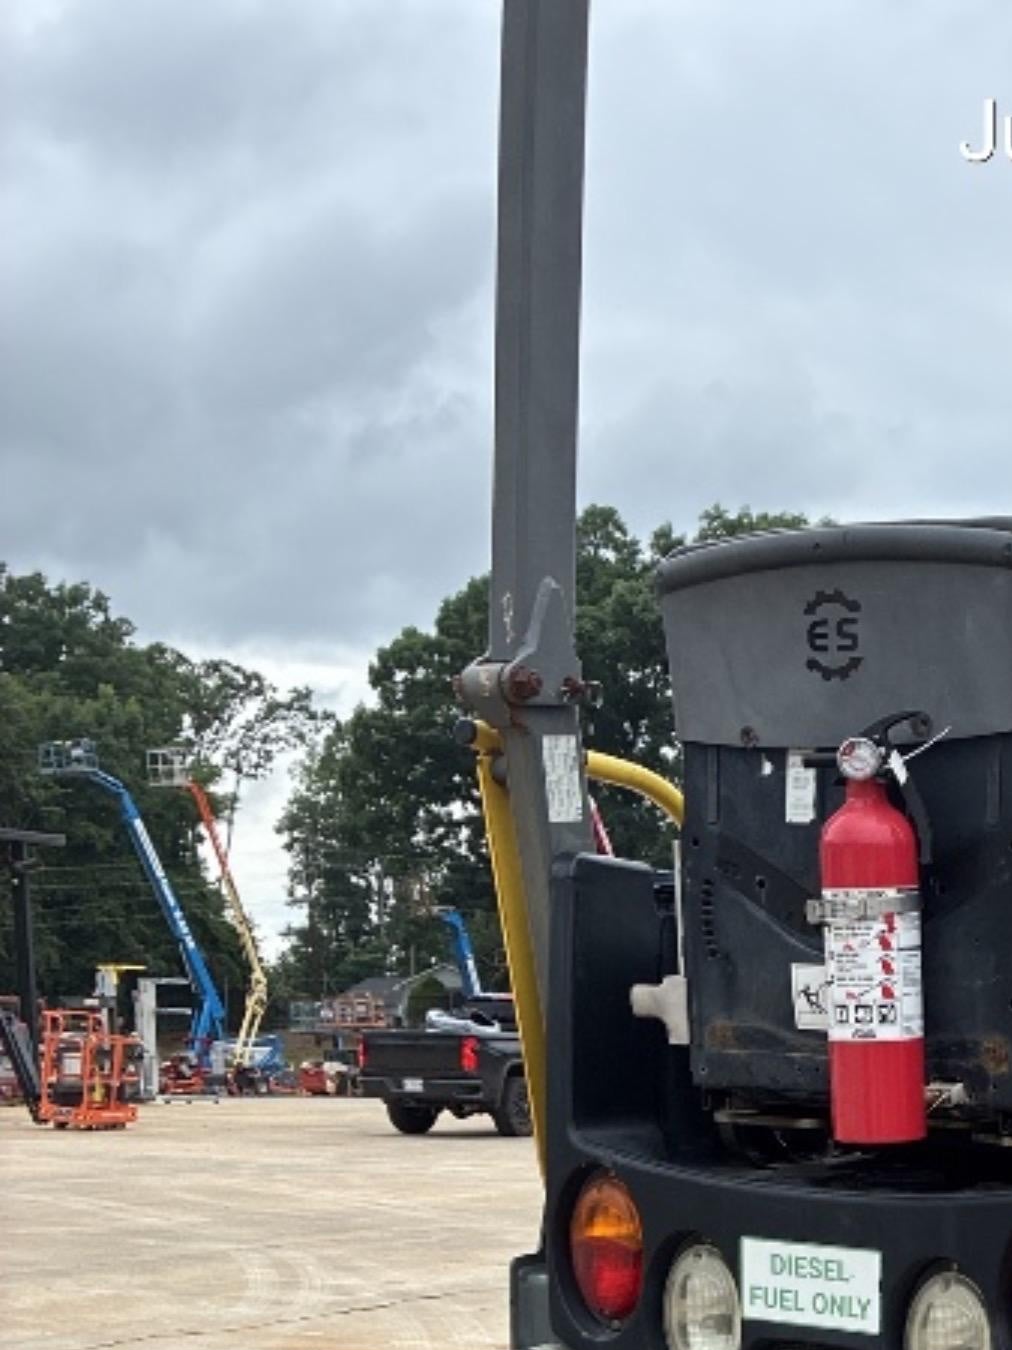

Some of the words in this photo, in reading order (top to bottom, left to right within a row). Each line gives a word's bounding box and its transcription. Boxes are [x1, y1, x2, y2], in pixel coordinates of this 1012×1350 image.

[806, 617, 859, 652] ES
[750, 1284, 806, 1312] FUEL
[812, 1293, 872, 1320] ONLY
